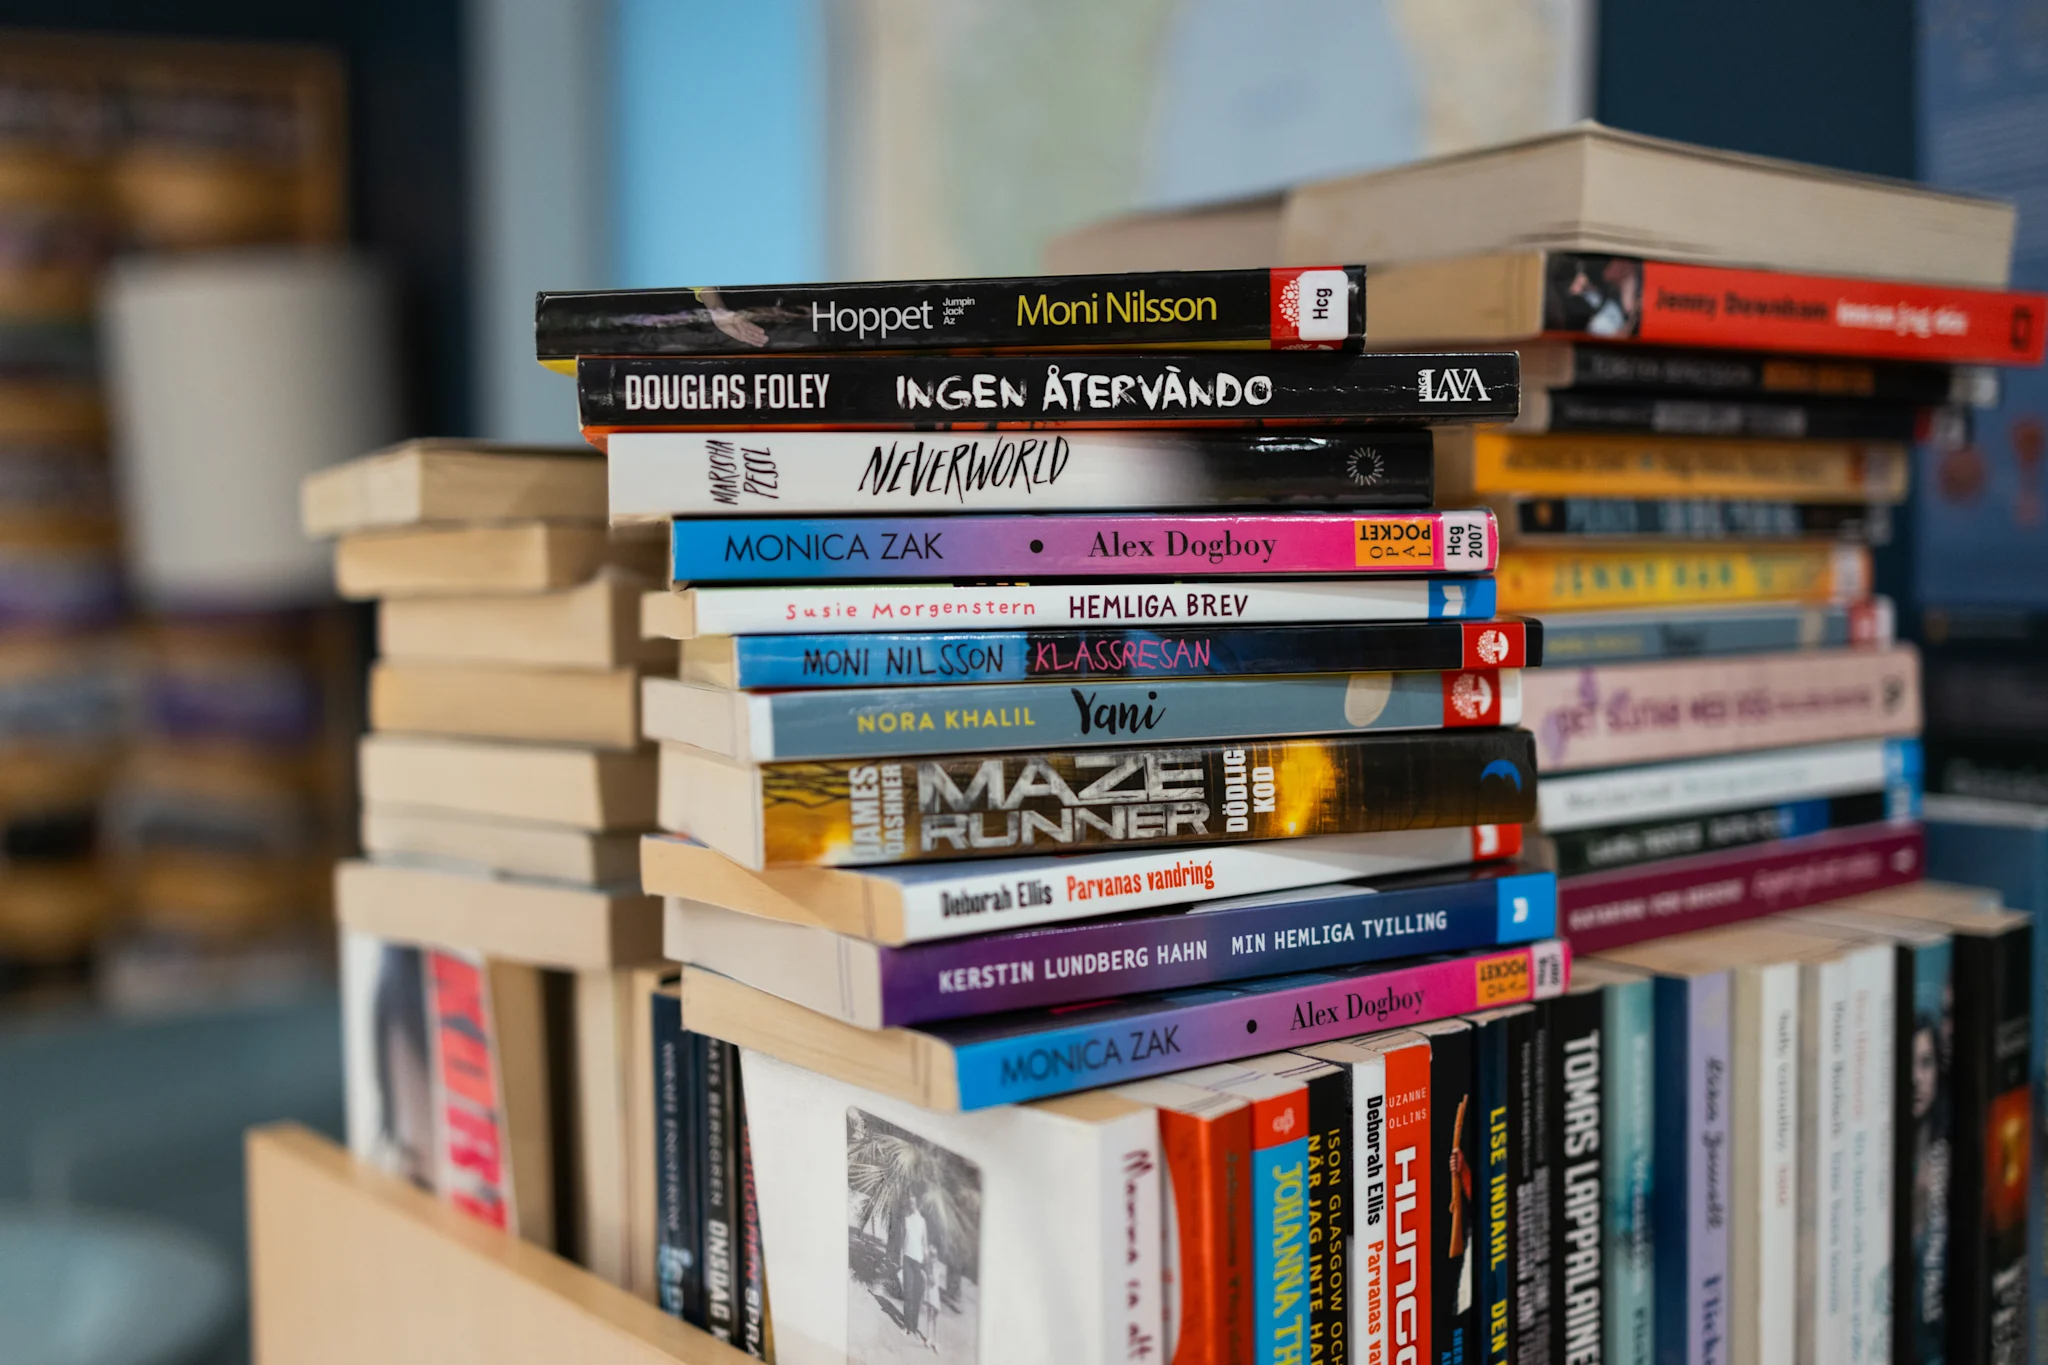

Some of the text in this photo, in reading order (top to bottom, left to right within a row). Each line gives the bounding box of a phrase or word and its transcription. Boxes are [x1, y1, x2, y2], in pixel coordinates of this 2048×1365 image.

[812, 300, 934, 340] Hoppet
[942, 297, 975, 307] Jumpin
[942, 306, 964, 316] Jack
[943, 316, 956, 325] Az
[1016, 290, 1217, 326] Moni Nilsson
[1312, 288, 1333, 320] Hcg
[625, 373, 830, 411] DOUGLAS FOLEY
[896, 373, 1027, 411] INGEN
[1418, 370, 1427, 399] UNGA
[1419, 368, 1492, 402] LAVA
[706, 439, 739, 505] MARISHA
[741, 447, 779, 499] PESSL
[858, 435, 1069, 504] NEVERWORLD
[725, 530, 1277, 564] MONICA ZAK Alex Dogboy
[1360, 524, 1431, 540] POCKET
[1447, 526, 1464, 556] Hcg
[1468, 524, 1483, 558] 2007
[786, 594, 1248, 620] Susie Morgenstern HEMLIGA BREV
[803, 639, 1211, 676] MONI NILSSON KLASSRESAN
[858, 688, 1166, 736] NORA KHALIL Yani
[917, 753, 1205, 812] MAZE
[1222, 749, 1248, 833] DÖDLIG
[1253, 766, 1275, 813] KOD
[849, 765, 879, 857] JAMES
[882, 764, 905, 856] DASHNER
[920, 800, 1211, 852] RUNNER
[940, 860, 1215, 919] Deborah Ellis Parvanas vandring
[939, 911, 1447, 993] KERSTIN LUNDBERG HAHN MIN HEMLIGA TVILLING
[1001, 987, 1425, 1085] MONICA ZAK Alex Dogboy
[1564, 1029, 1599, 1158] TOMAS
[1308, 1135, 1324, 1188] NÄR
[1327, 1128, 1341, 1185] ISON
[1367, 1095, 1383, 1178] Deborah
[1308, 1200, 1323, 1244] JAG
[1367, 1181, 1384, 1226] Ellis
[1490, 1106, 1508, 1353] LISE INDAHL DEN
[1273, 1162, 1303, 1318] JOHANNA
[1329, 1194, 1343, 1311] GLASGOW
[708, 1219, 730, 1322] ONSDAG
[1309, 1254, 1323, 1312] INTE
[1368, 1240, 1384, 1336] Parvanas
